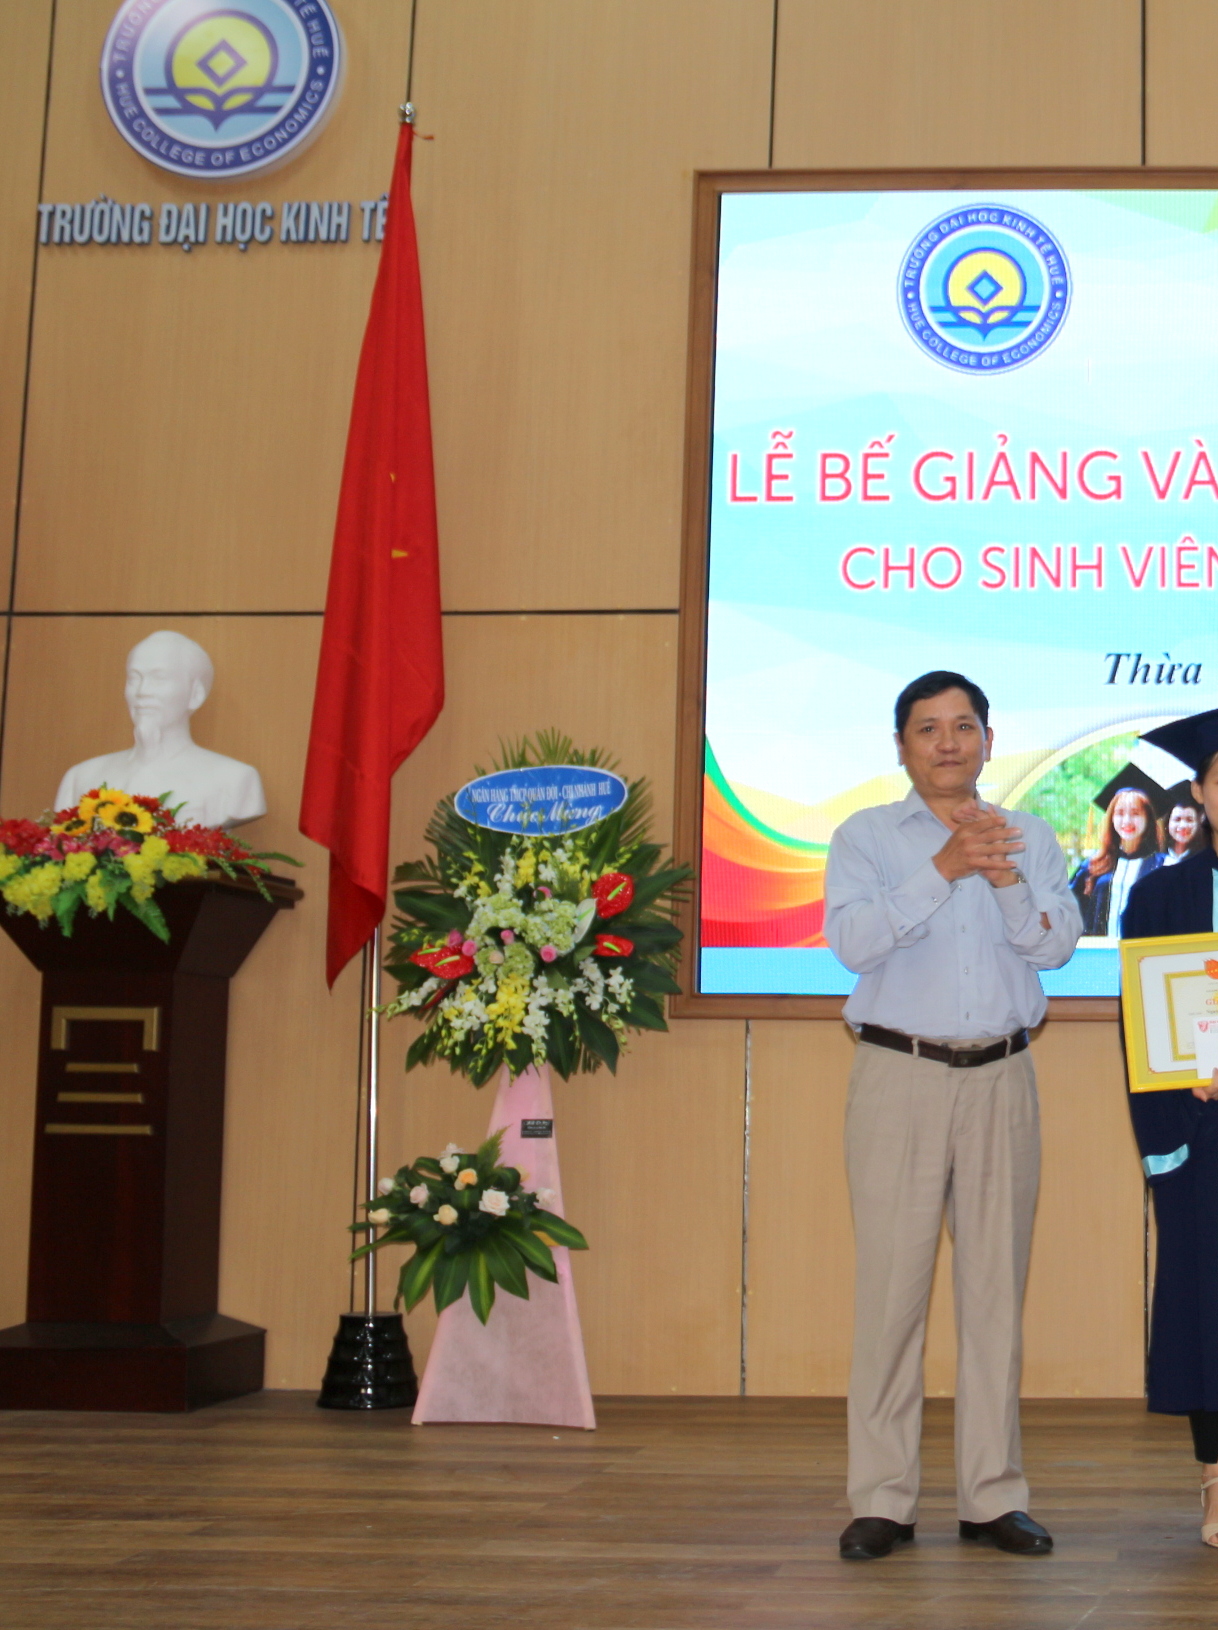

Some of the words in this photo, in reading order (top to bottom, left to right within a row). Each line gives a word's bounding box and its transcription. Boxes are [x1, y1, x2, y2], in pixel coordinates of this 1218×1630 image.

[116, 81, 137, 119] HUE
[132, 119, 206, 166] COLLEGE
[211, 152, 235, 166] OF
[239, 80, 324, 163] ECONOMICS
[37, 193, 152, 245] TRƯỜNG
[158, 202, 209, 252] ĐẠI
[214, 202, 274, 252] HỌC
[280, 201, 351, 243] KINH
[1002, 213, 1036, 238] KINH
[907, 303, 925, 331] HUE
[922, 330, 977, 366] COLLEGE
[981, 355, 999, 367] OF
[1002, 301, 1061, 364] ECONOMICS
[729, 430, 795, 504] LỄ
[818, 433, 896, 503] BẾ
[912, 433, 1123, 503] GIẢNG
[840, 545, 963, 590] CHO
[980, 545, 1104, 590] SINH
[1104, 652, 1203, 686] Thừa
